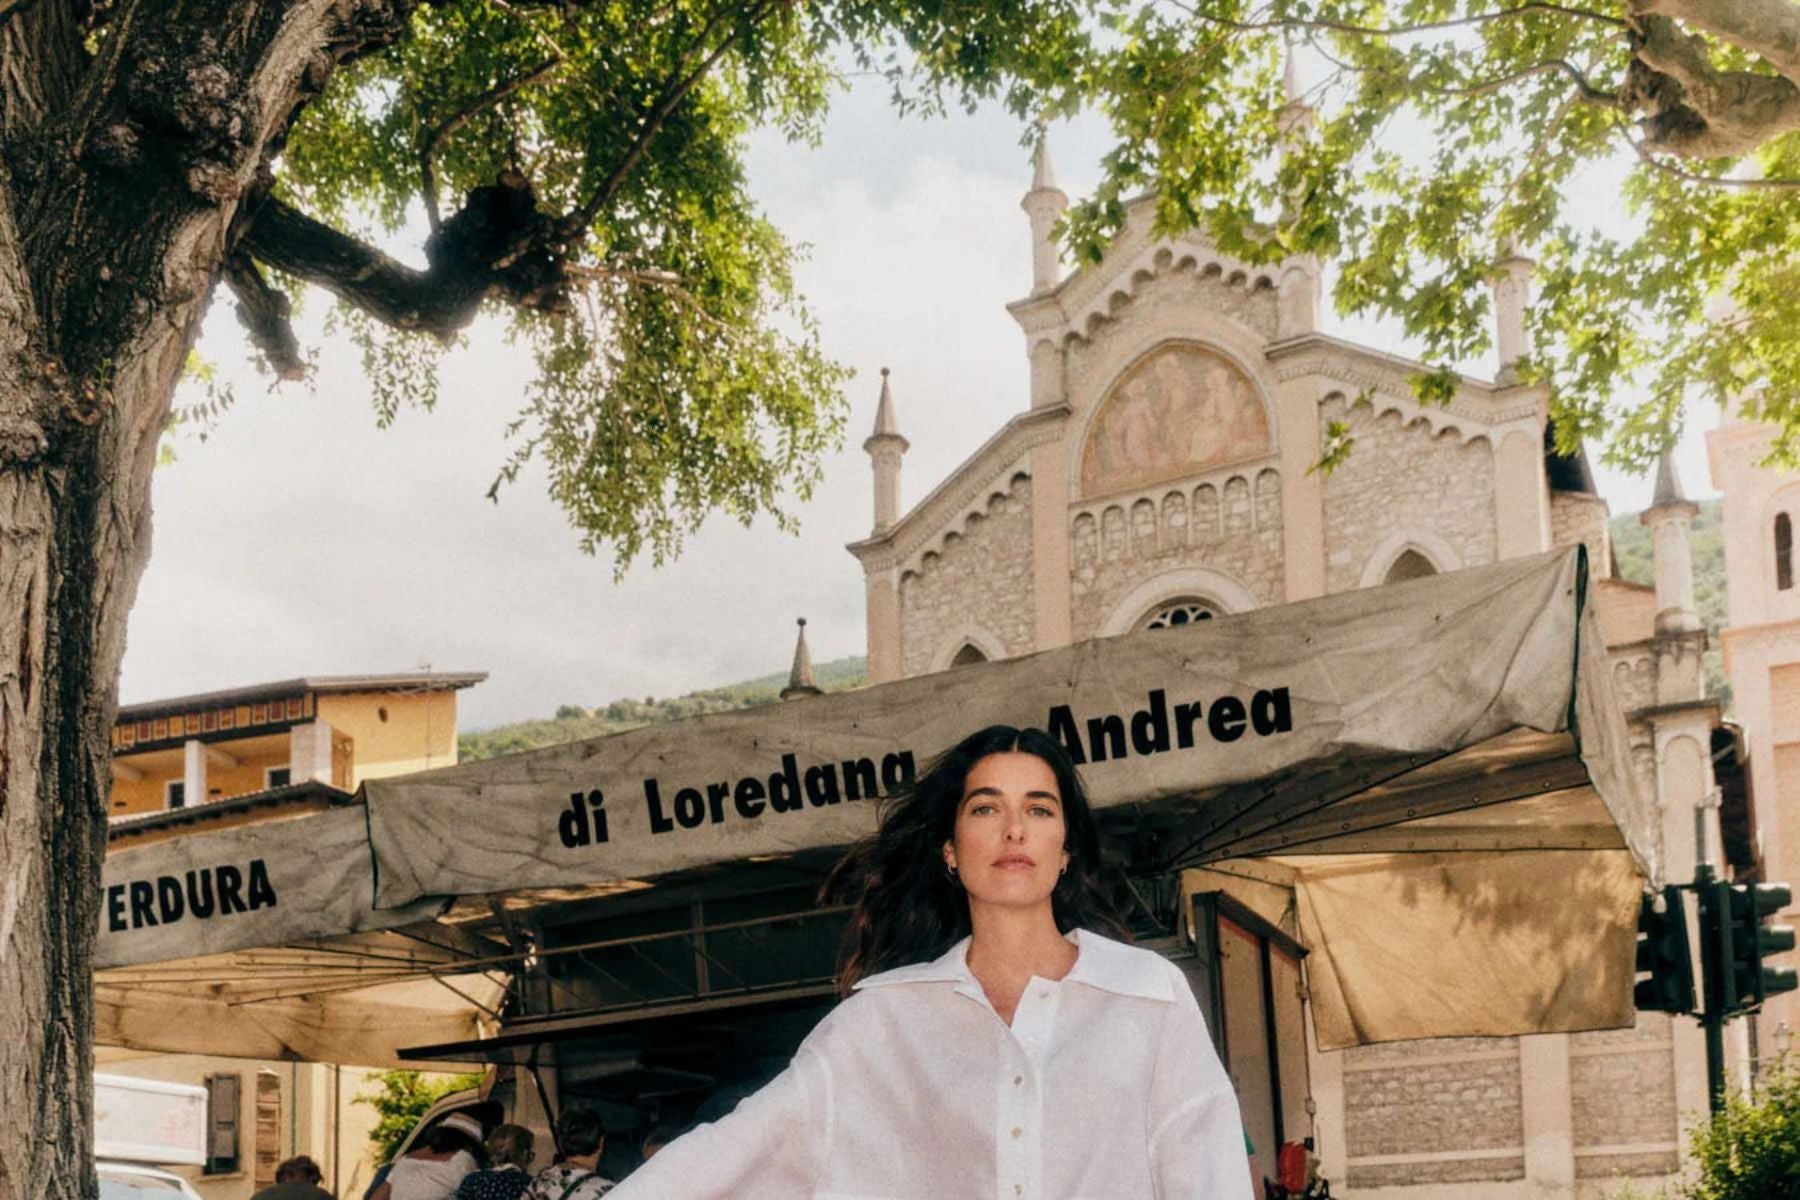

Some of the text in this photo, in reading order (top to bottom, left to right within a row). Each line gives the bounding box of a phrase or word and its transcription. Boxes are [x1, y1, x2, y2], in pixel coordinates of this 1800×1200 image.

[558, 686, 1293, 849] di Loredana Andrea
[100, 858, 278, 933] ERDURA
